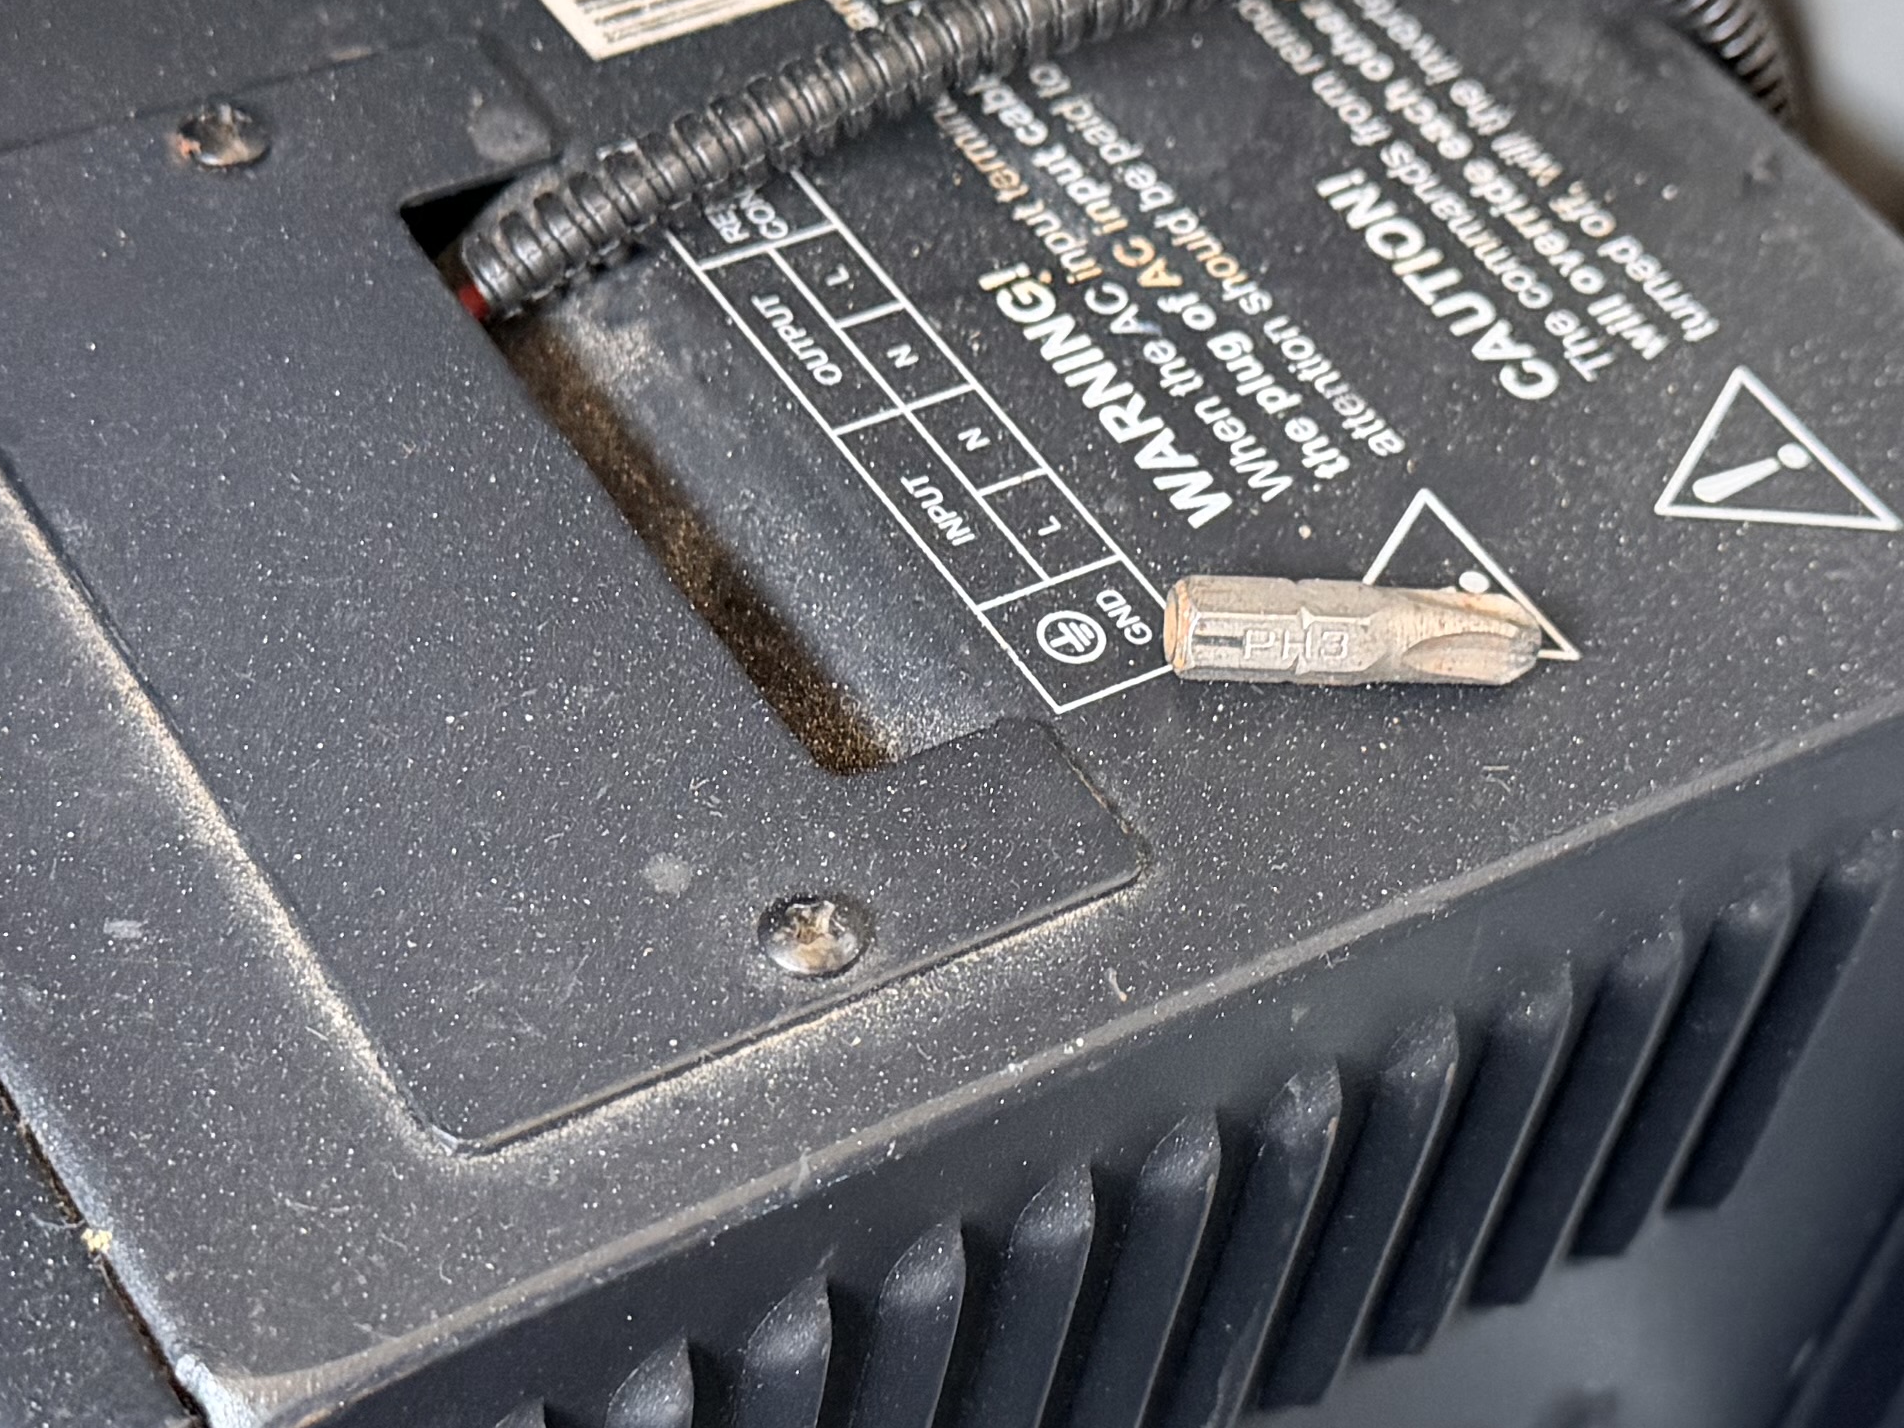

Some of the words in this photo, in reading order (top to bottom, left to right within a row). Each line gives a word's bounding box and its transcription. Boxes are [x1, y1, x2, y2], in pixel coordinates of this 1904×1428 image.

[970, 77, 1048, 146] cabl
[1030, 65, 1070, 97] to
[1313, 72, 1390, 145] from
[1450, 81, 1512, 134] the
[935, 96, 1029, 202] termin
[1052, 98, 1142, 164] paid
[1385, 80, 1472, 159] each
[1031, 144, 1127, 236] input
[1124, 166, 1174, 211] be
[1492, 133, 1560, 186] will
[1014, 199, 1102, 280] input
[1381, 142, 1553, 308] commands
[1464, 160, 1605, 294] override
[1549, 182, 1615, 237] off,
[827, 265, 849, 286] L
[1113, 236, 1182, 286] AC
[1155, 208, 1272, 314] should
[1317, 170, 1558, 399] CAUTION!
[1597, 236, 1719, 341] turned
[752, 297, 842, 385] OUTPUT
[1085, 283, 1159, 333] AC
[1157, 292, 1216, 330] of
[1588, 294, 1667, 359] will
[887, 344, 918, 368] N
[1143, 340, 1203, 396] the
[1207, 331, 1301, 414] plug
[1545, 310, 1613, 381] The
[979, 264, 1232, 528] WARNING!
[1264, 316, 1404, 456] attention
[958, 428, 990, 451] N
[1195, 396, 1293, 502] When
[1285, 417, 1350, 479] the
[900, 476, 975, 546] INPUT
[1038, 515, 1061, 536] L
[1096, 588, 1152, 644] GND
[1242, 627, 1350, 662] PH3
